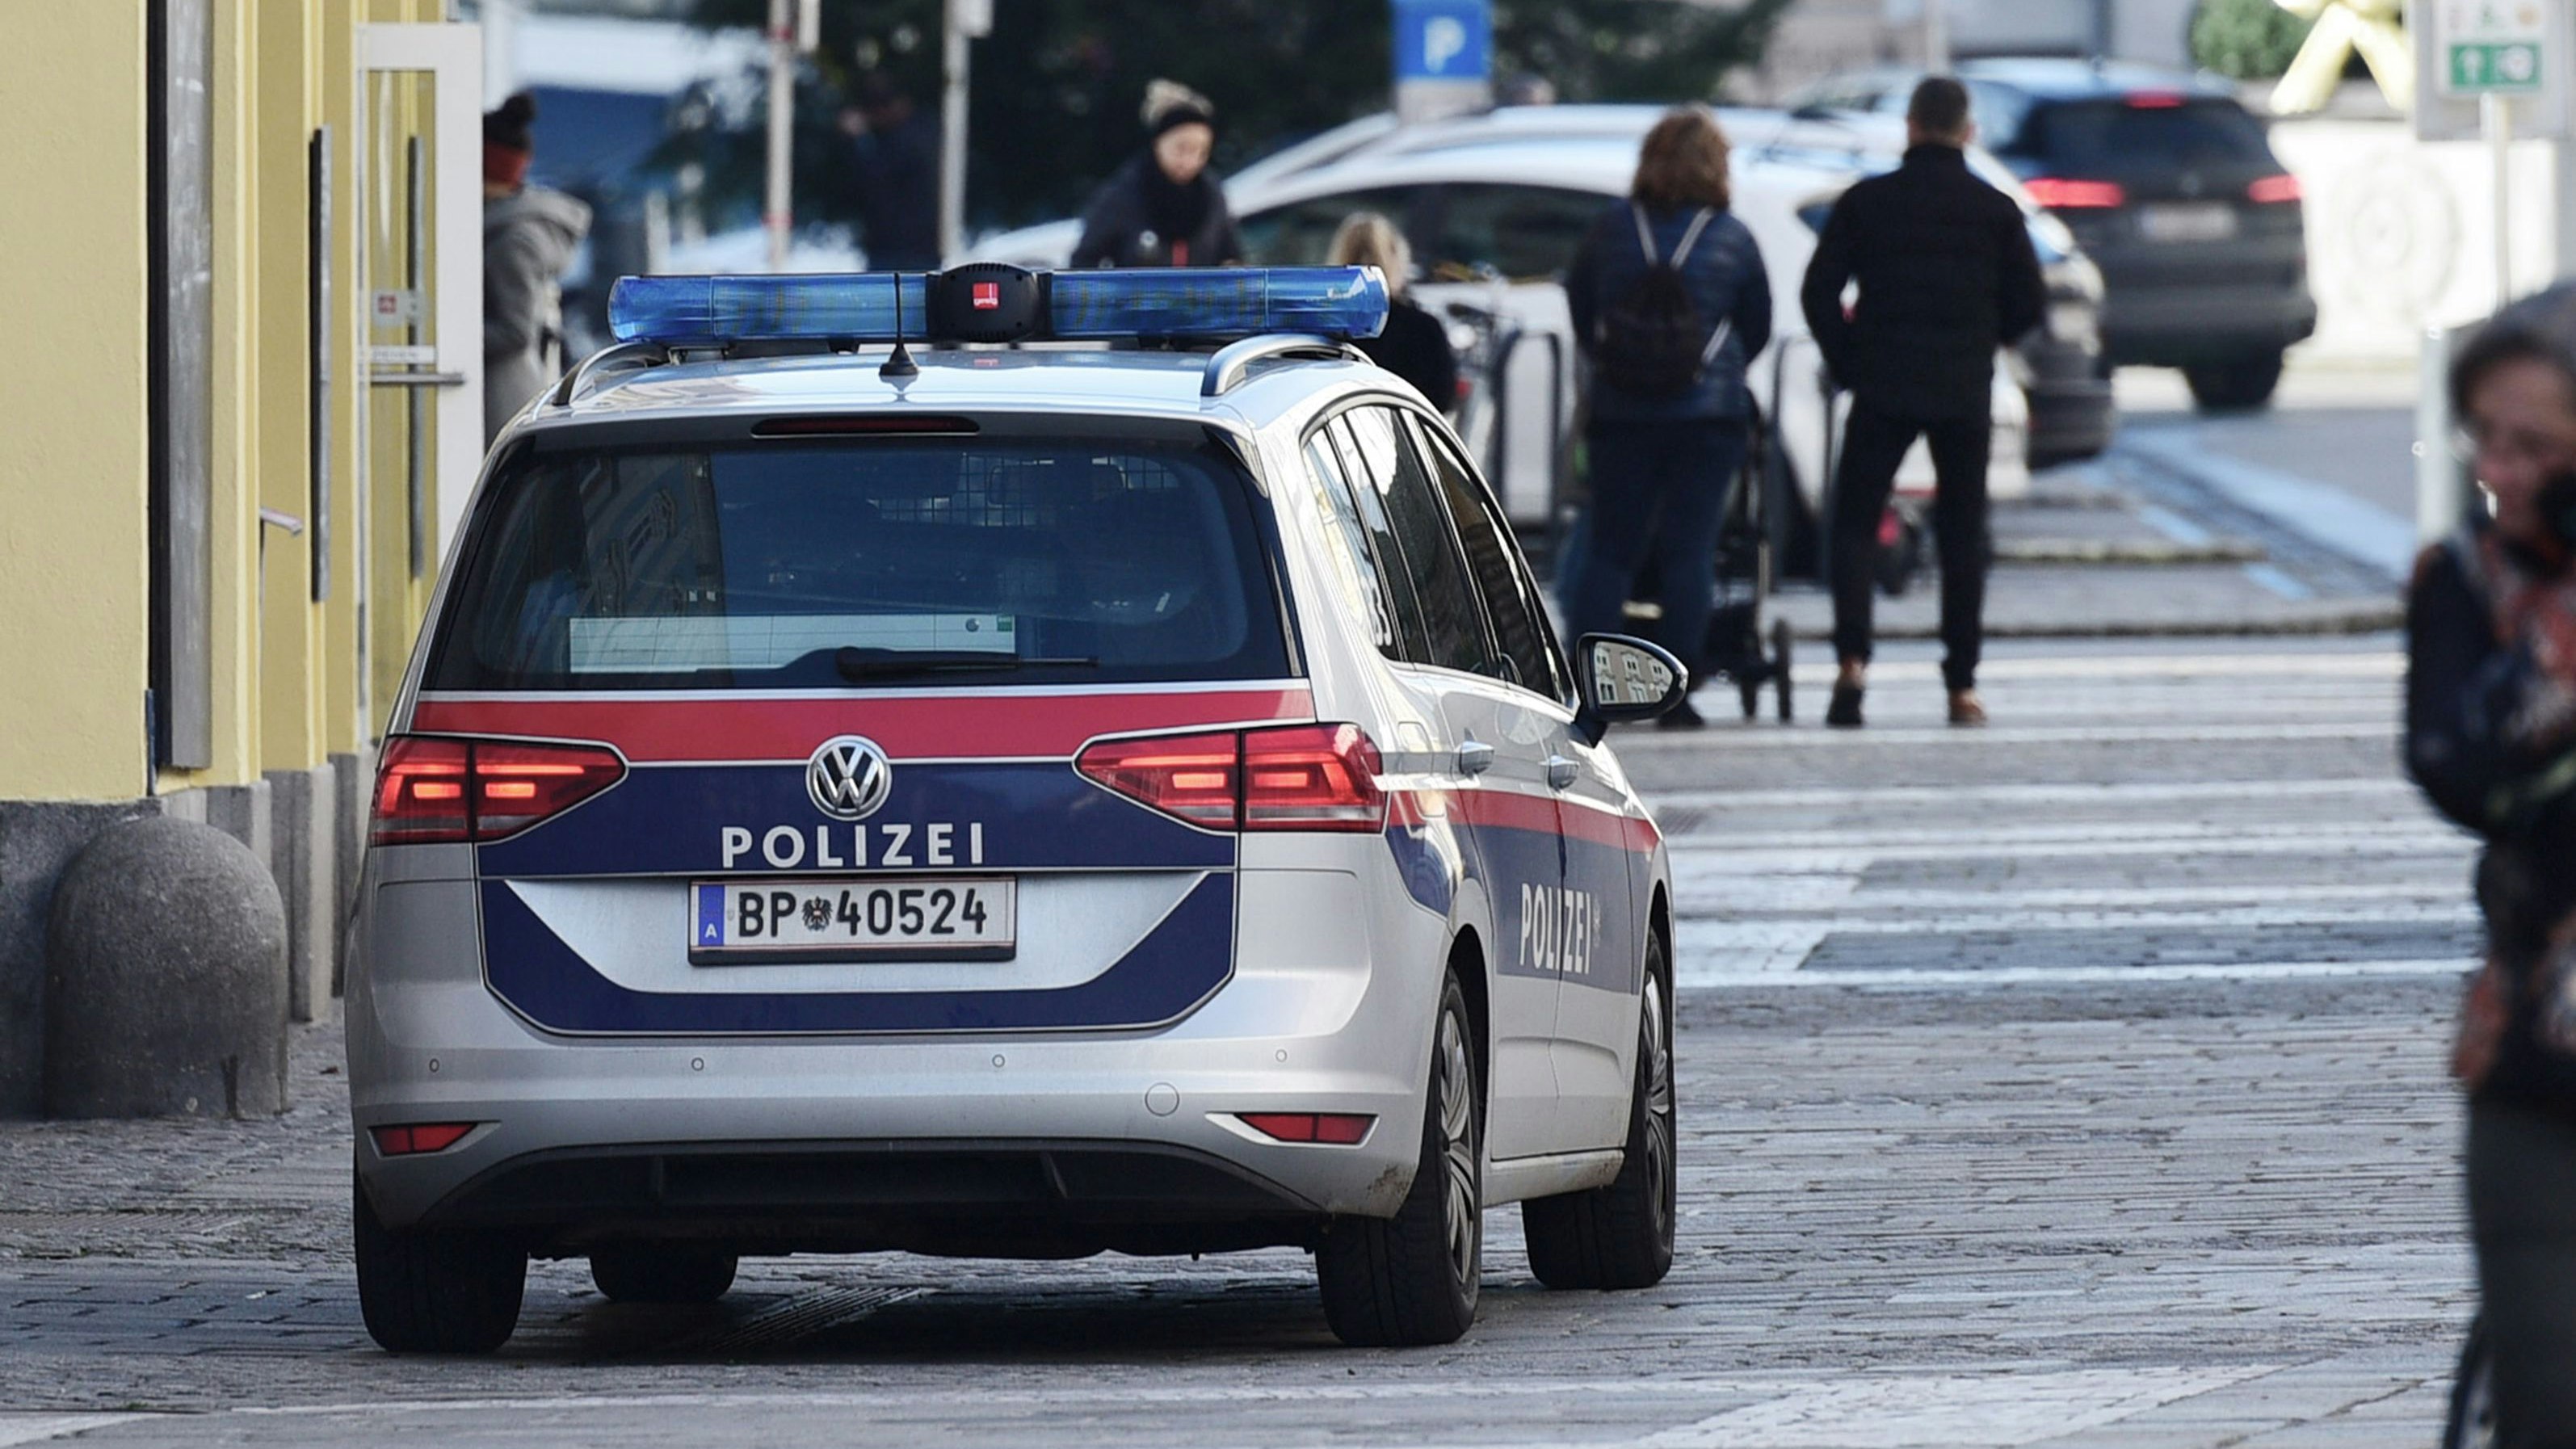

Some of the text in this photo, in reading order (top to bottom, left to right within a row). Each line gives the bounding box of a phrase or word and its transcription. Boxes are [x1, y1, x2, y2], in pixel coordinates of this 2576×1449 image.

[1423, 16, 1466, 74] P
[810, 745, 885, 811] VW
[722, 822, 983, 868] POLIZEI
[704, 923, 717, 938] A
[739, 888, 987, 938] BP 40524
[1519, 883, 1591, 974] POLIZEI
